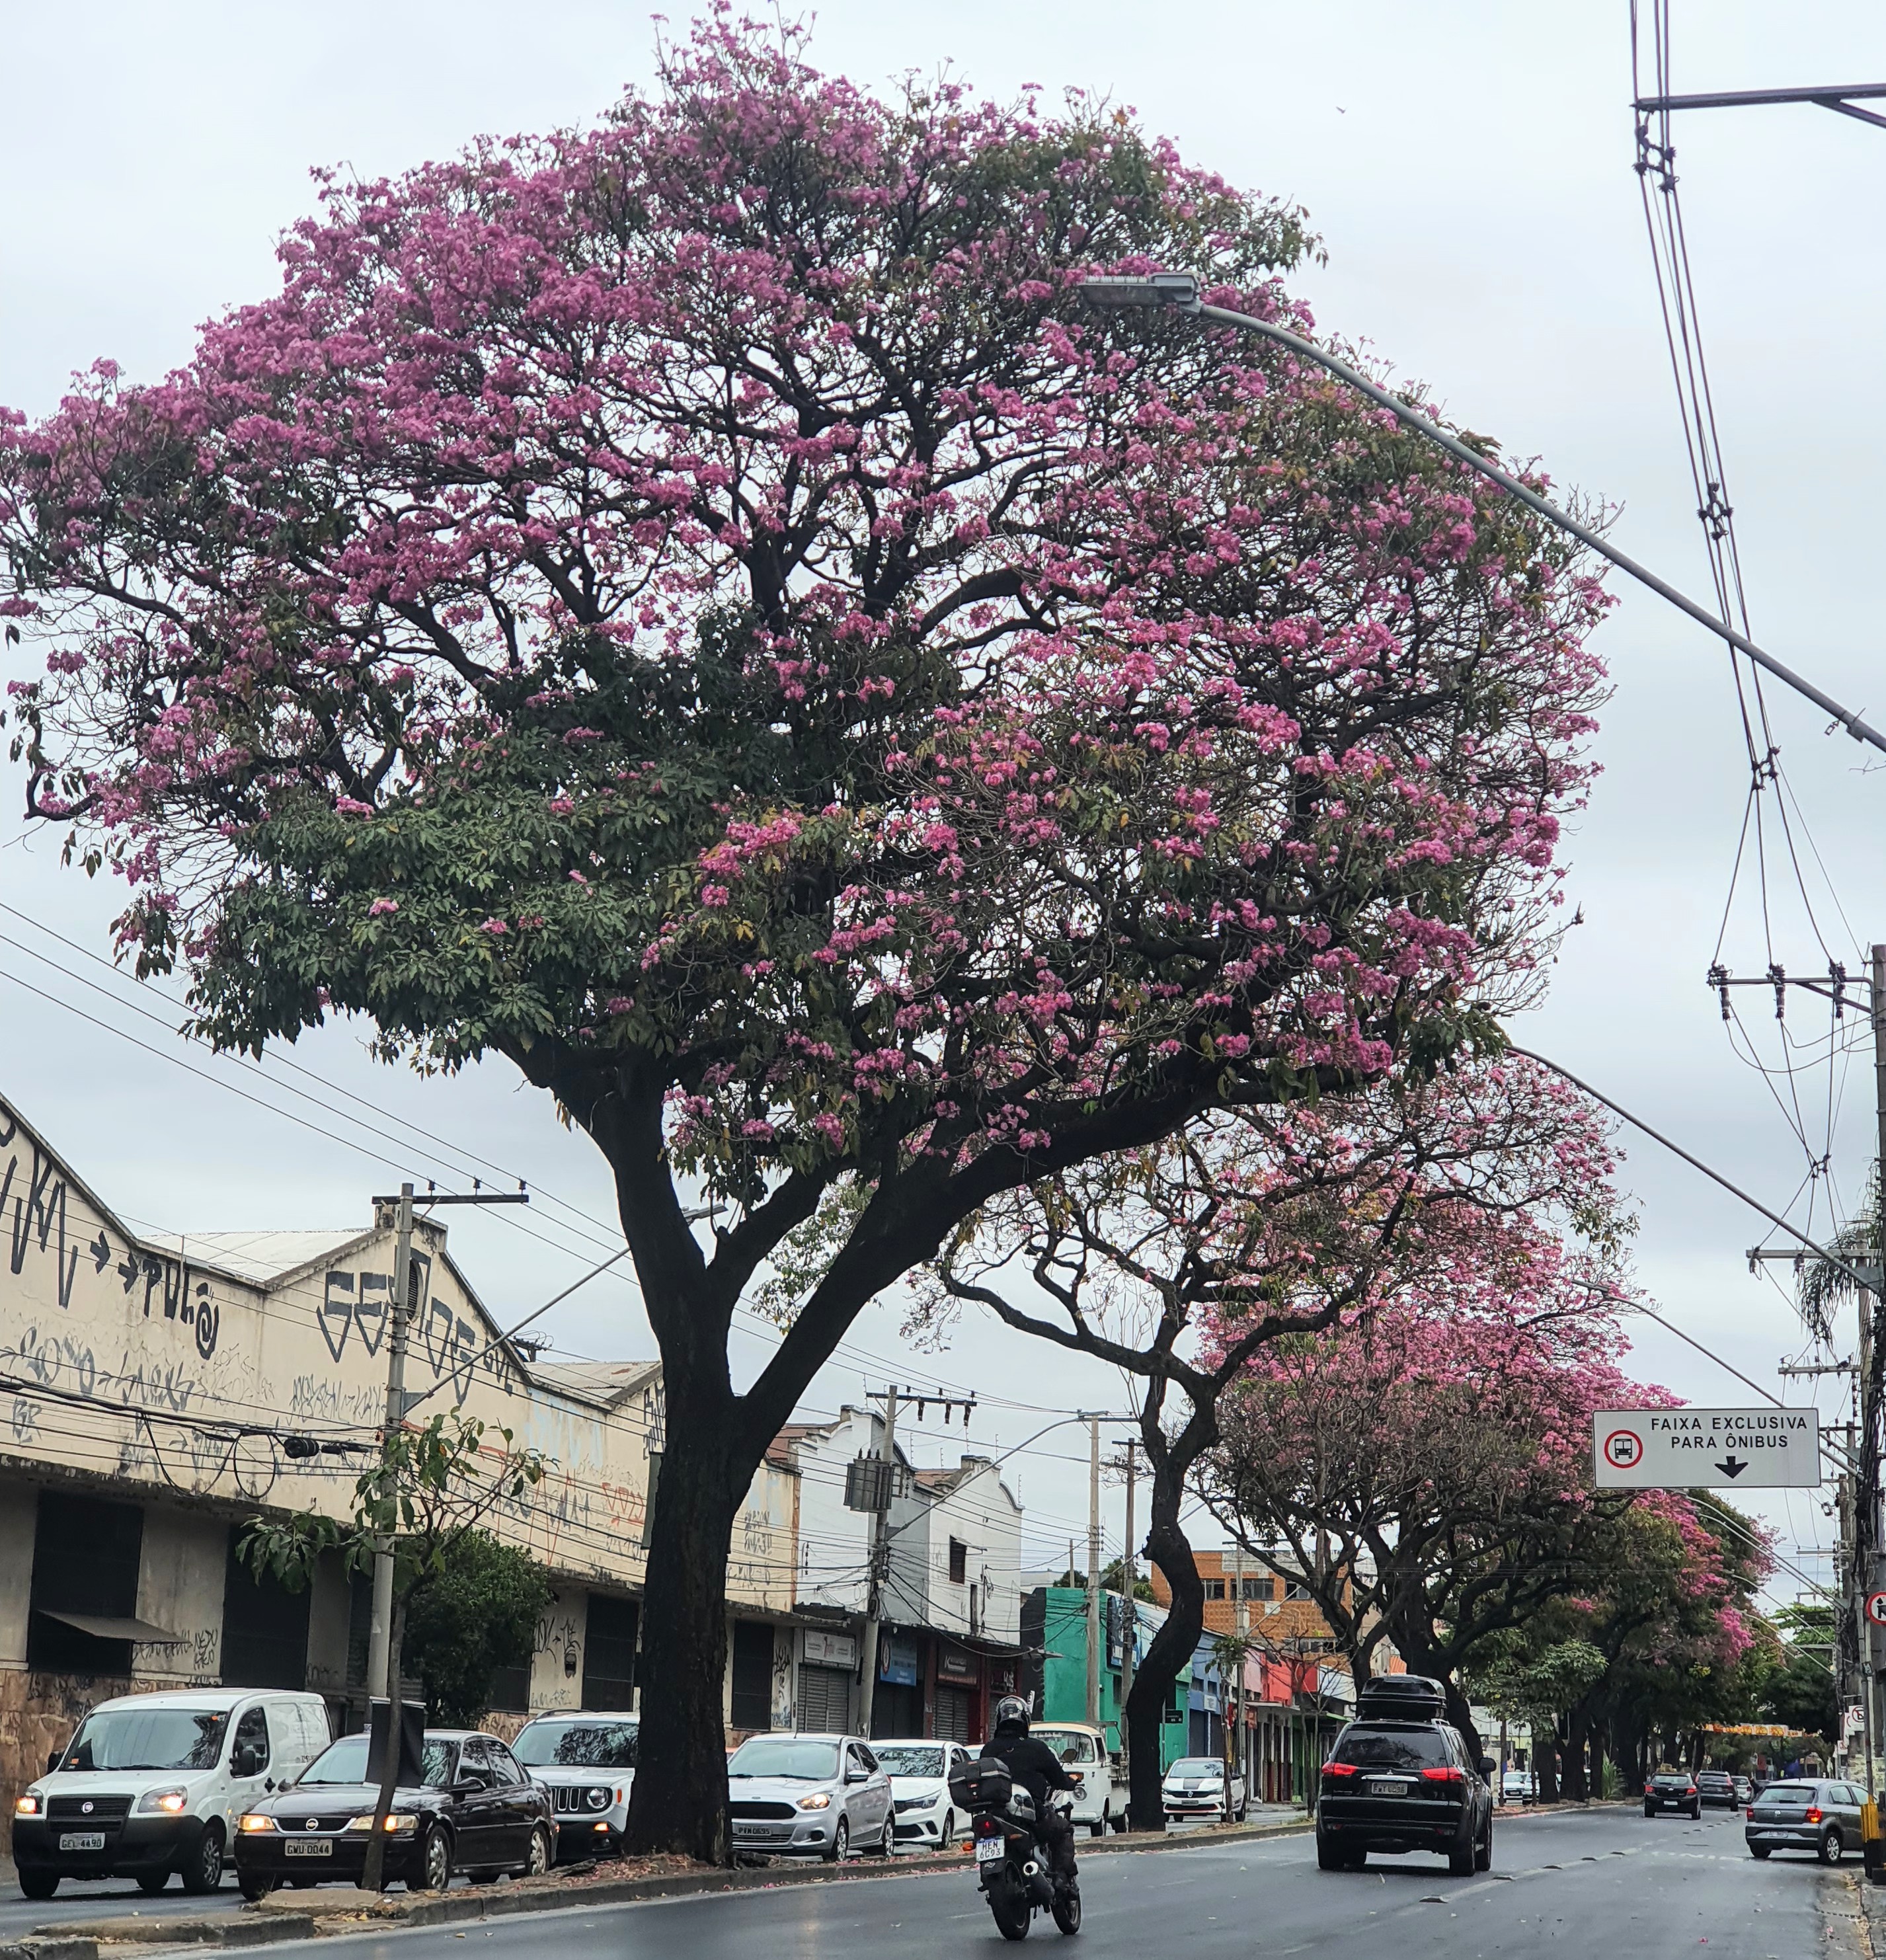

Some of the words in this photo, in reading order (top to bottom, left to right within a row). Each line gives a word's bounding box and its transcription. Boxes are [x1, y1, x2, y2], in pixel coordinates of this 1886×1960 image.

[1651, 1417, 1702, 1431] FAIXA
[1712, 1417, 1807, 1430] EXCLUSIVA
[1671, 1436, 1717, 1448] PARA
[1725, 1432, 1788, 1448] ÔNIBUS
[982, 1840, 998, 1851] HEN
